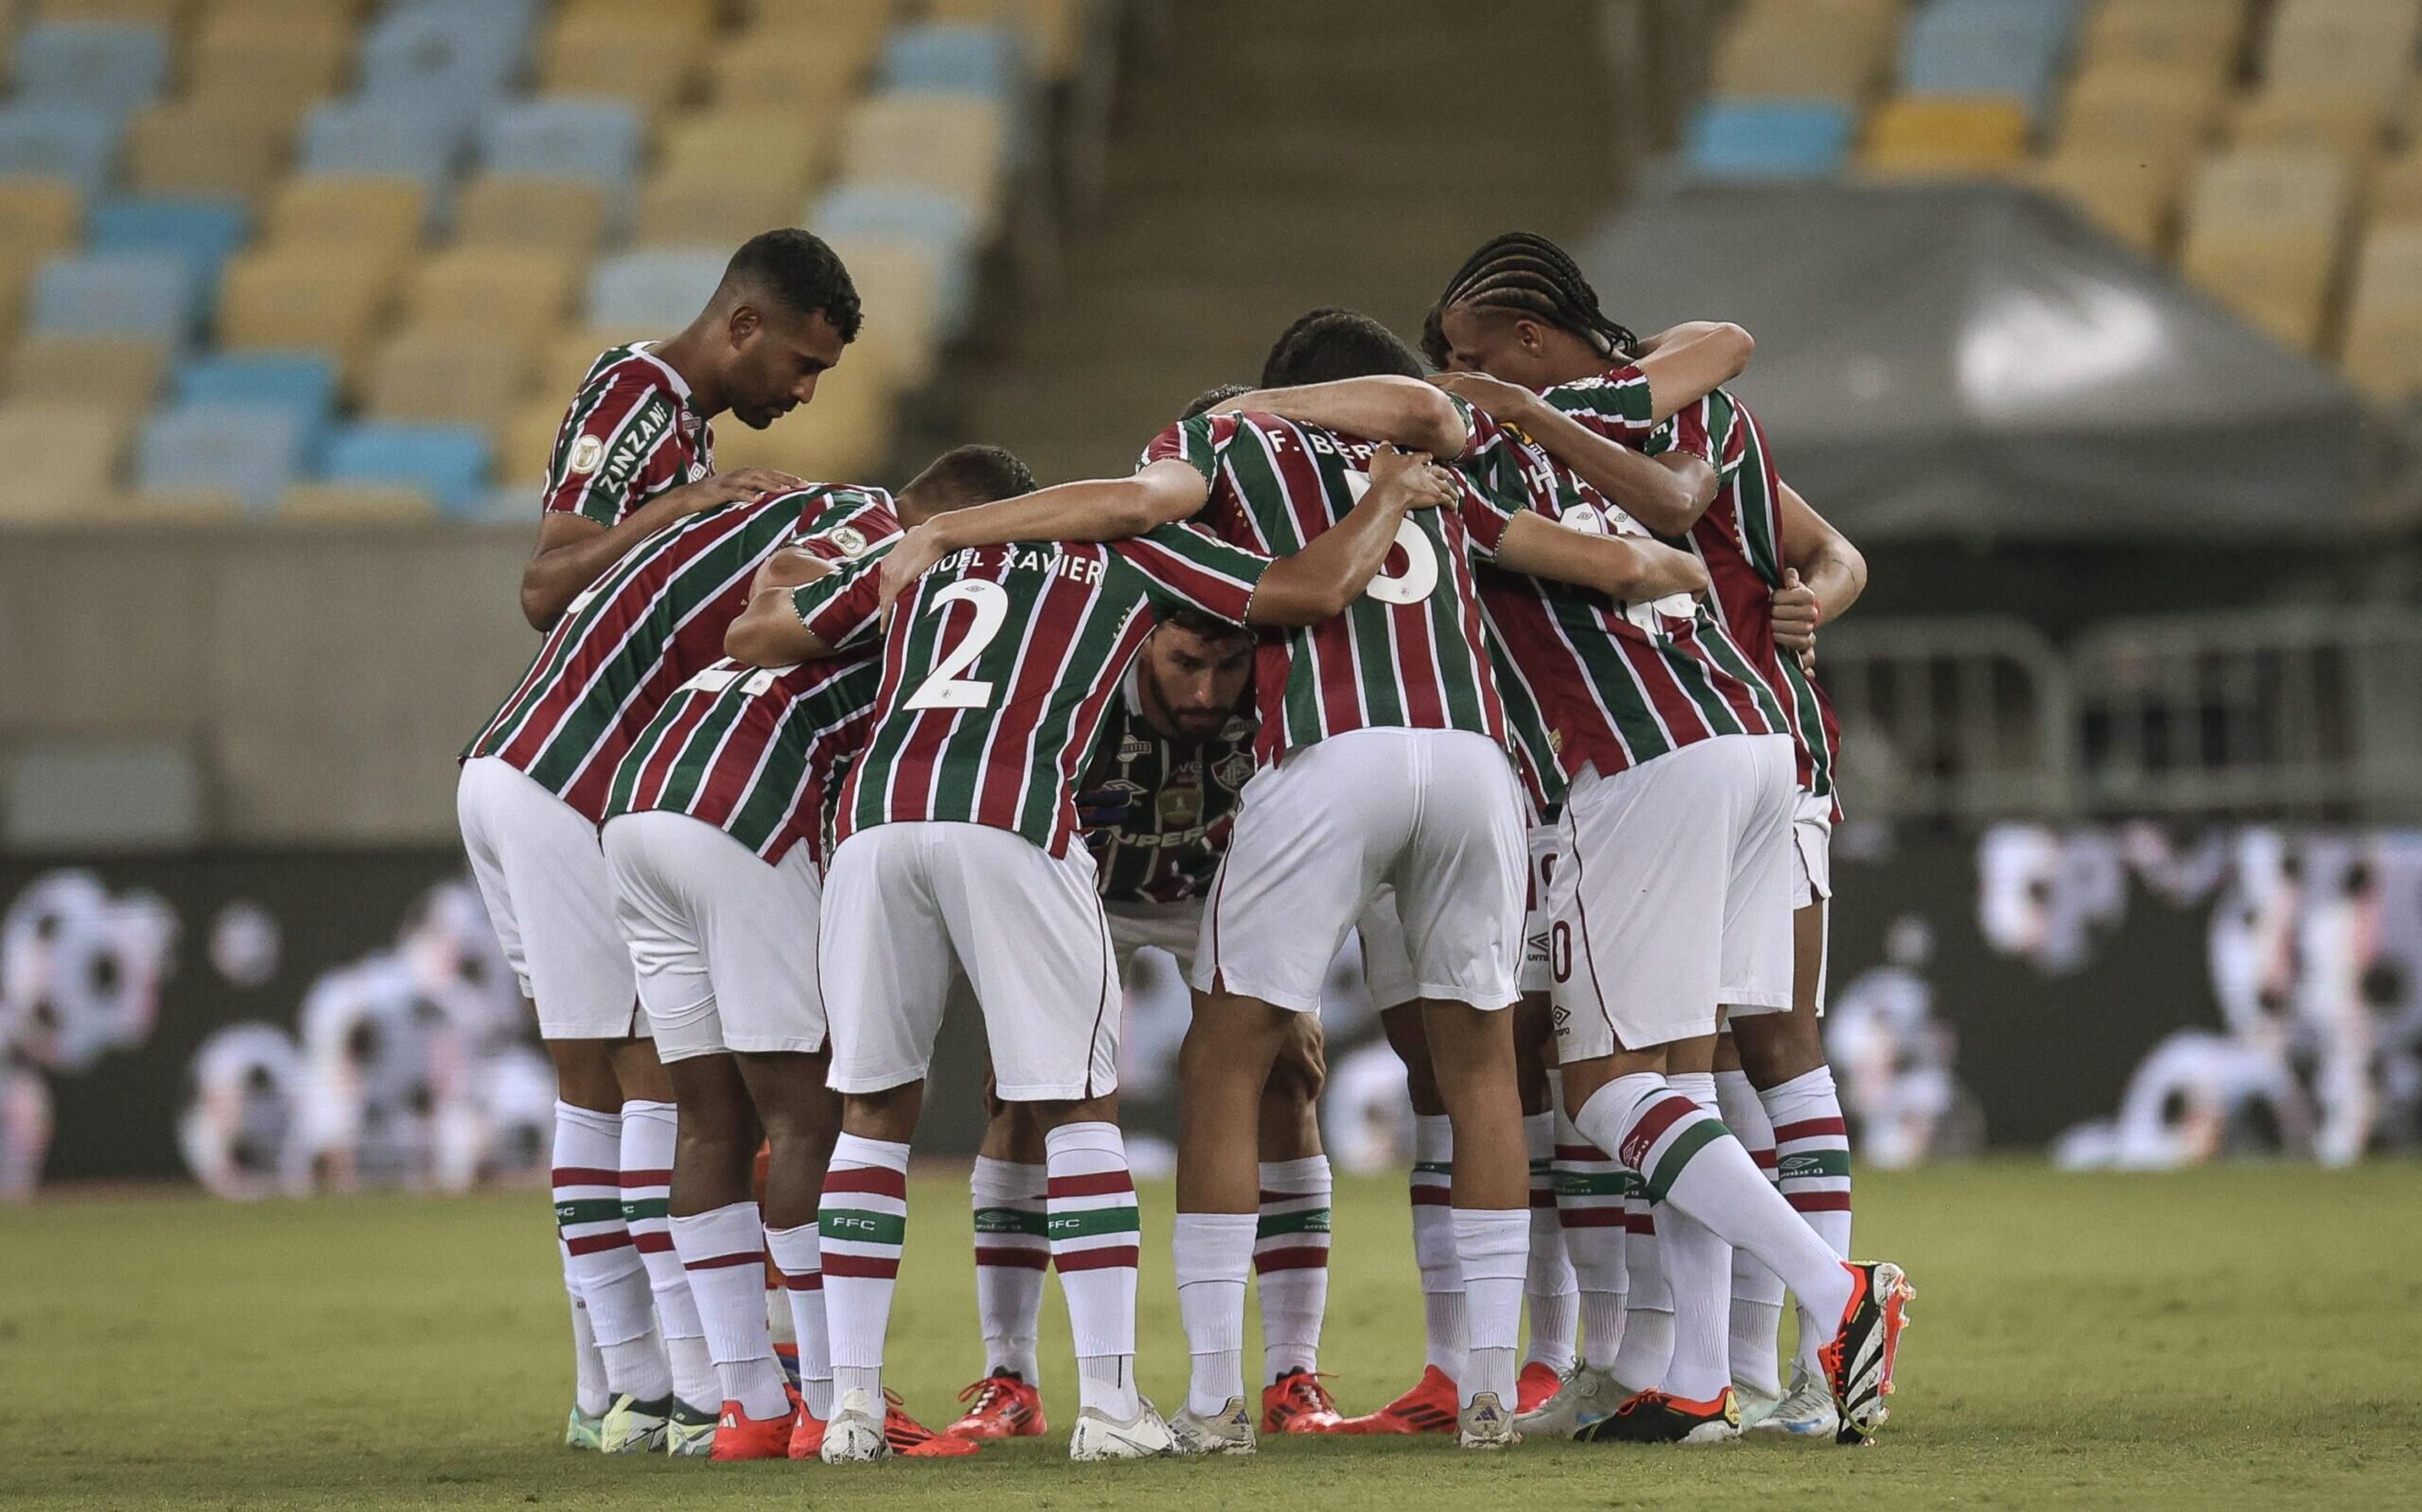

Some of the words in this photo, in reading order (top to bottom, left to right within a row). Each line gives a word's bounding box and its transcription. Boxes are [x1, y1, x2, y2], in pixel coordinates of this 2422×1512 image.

[997, 550, 1104, 587] XAVIER
[902, 578, 1009, 711] 2
[833, 1217, 876, 1231] FFC
